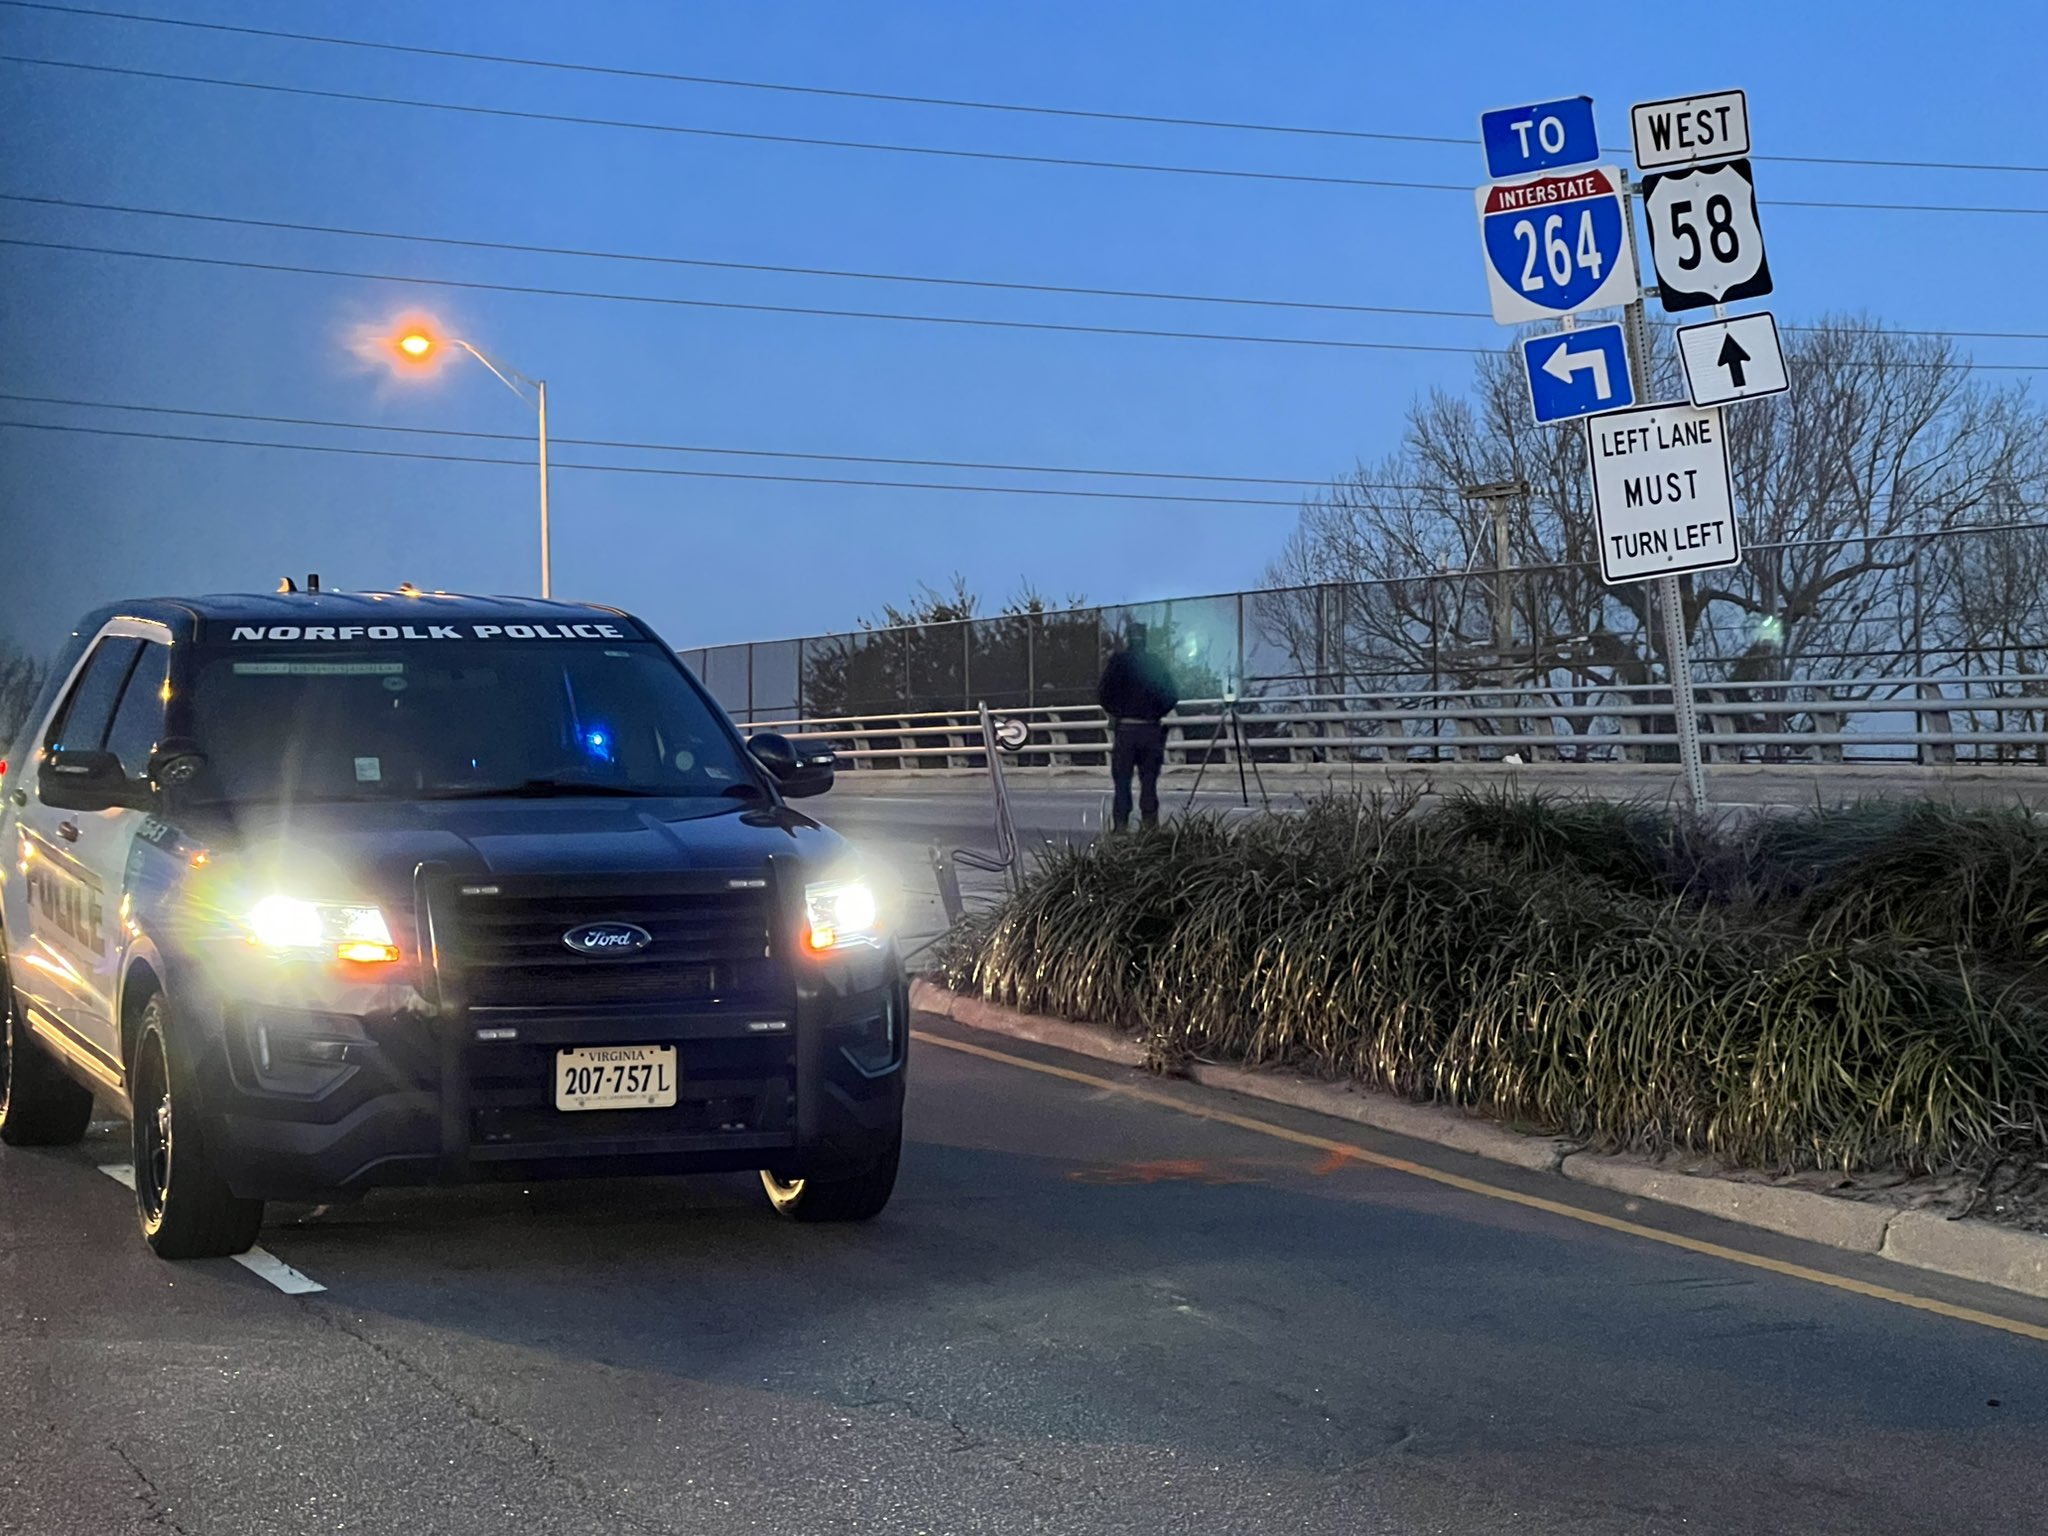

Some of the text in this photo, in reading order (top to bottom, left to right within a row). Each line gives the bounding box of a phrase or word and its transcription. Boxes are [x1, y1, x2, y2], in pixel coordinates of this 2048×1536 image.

[1511, 116, 1565, 158] TO
[1649, 106, 1731, 151] WEST
[1498, 177, 1597, 208] INTERSTATE
[1514, 209, 1603, 291] 264
[1670, 194, 1740, 271] 58
[1602, 419, 1712, 457] LEFT LANE
[1624, 469, 1698, 508] MUST
[1611, 520, 1724, 559] TURN LEFT
[231, 624, 624, 641] NORFOLK POLICE
[584, 931, 630, 946] Ford
[588, 1050, 645, 1062] VIRGINIA
